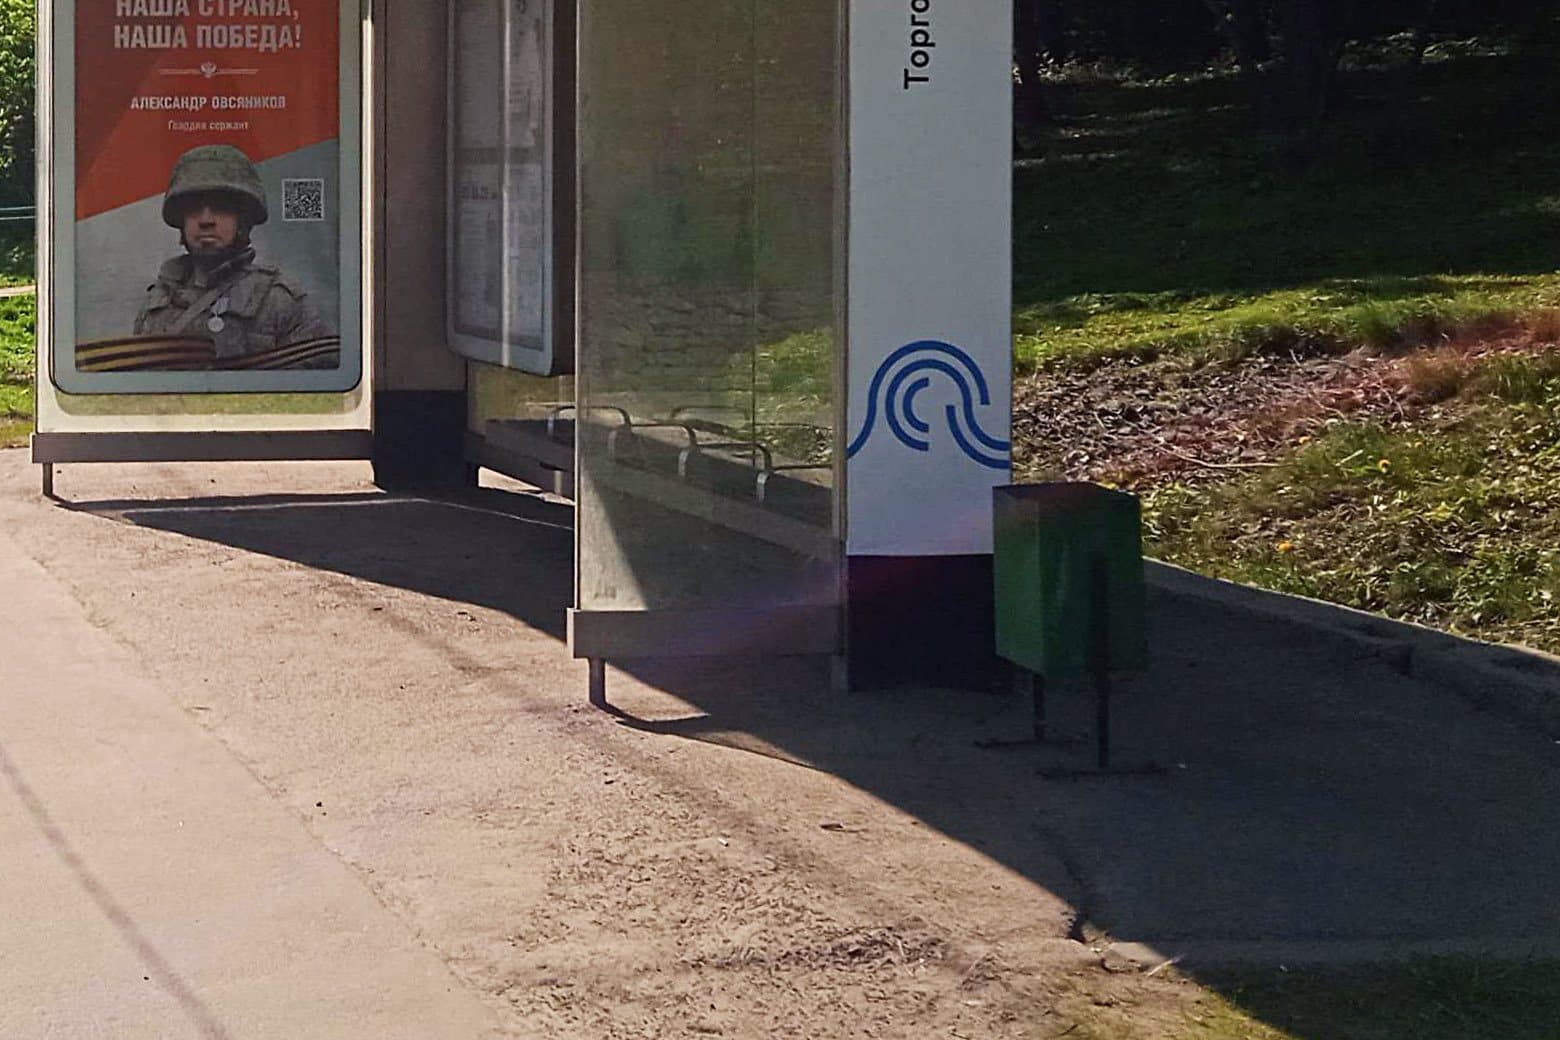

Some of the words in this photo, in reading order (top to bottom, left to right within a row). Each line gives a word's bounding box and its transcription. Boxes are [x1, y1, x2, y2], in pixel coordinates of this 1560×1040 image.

[114, 24, 188, 49] НАША
[196, 24, 301, 53] ПОБЕДА!
[130, 96, 207, 112] АЛЕКСАНДР
